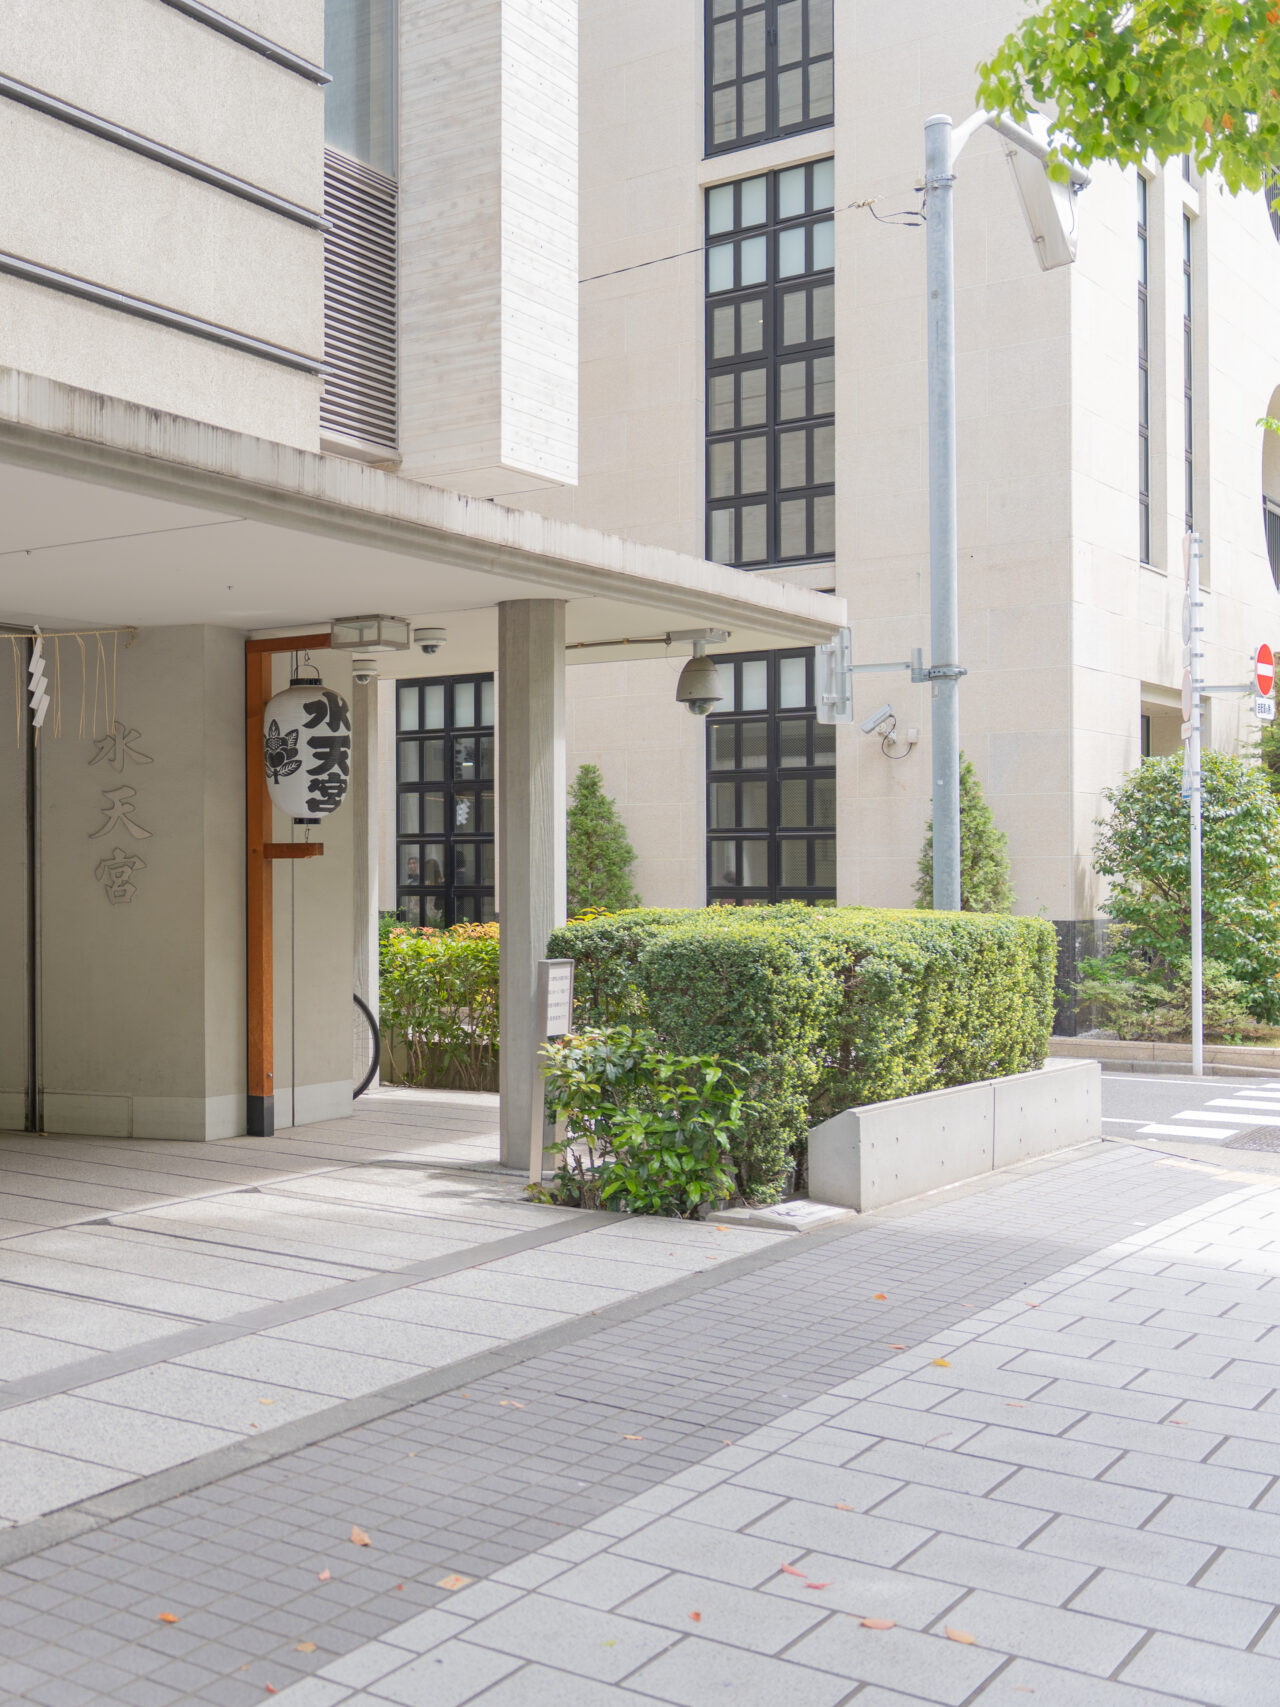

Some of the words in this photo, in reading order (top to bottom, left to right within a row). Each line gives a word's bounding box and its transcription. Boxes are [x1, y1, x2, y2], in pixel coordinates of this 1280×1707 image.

[87, 720, 154, 906] 水天宮
[302, 691, 352, 814] 水天宮
